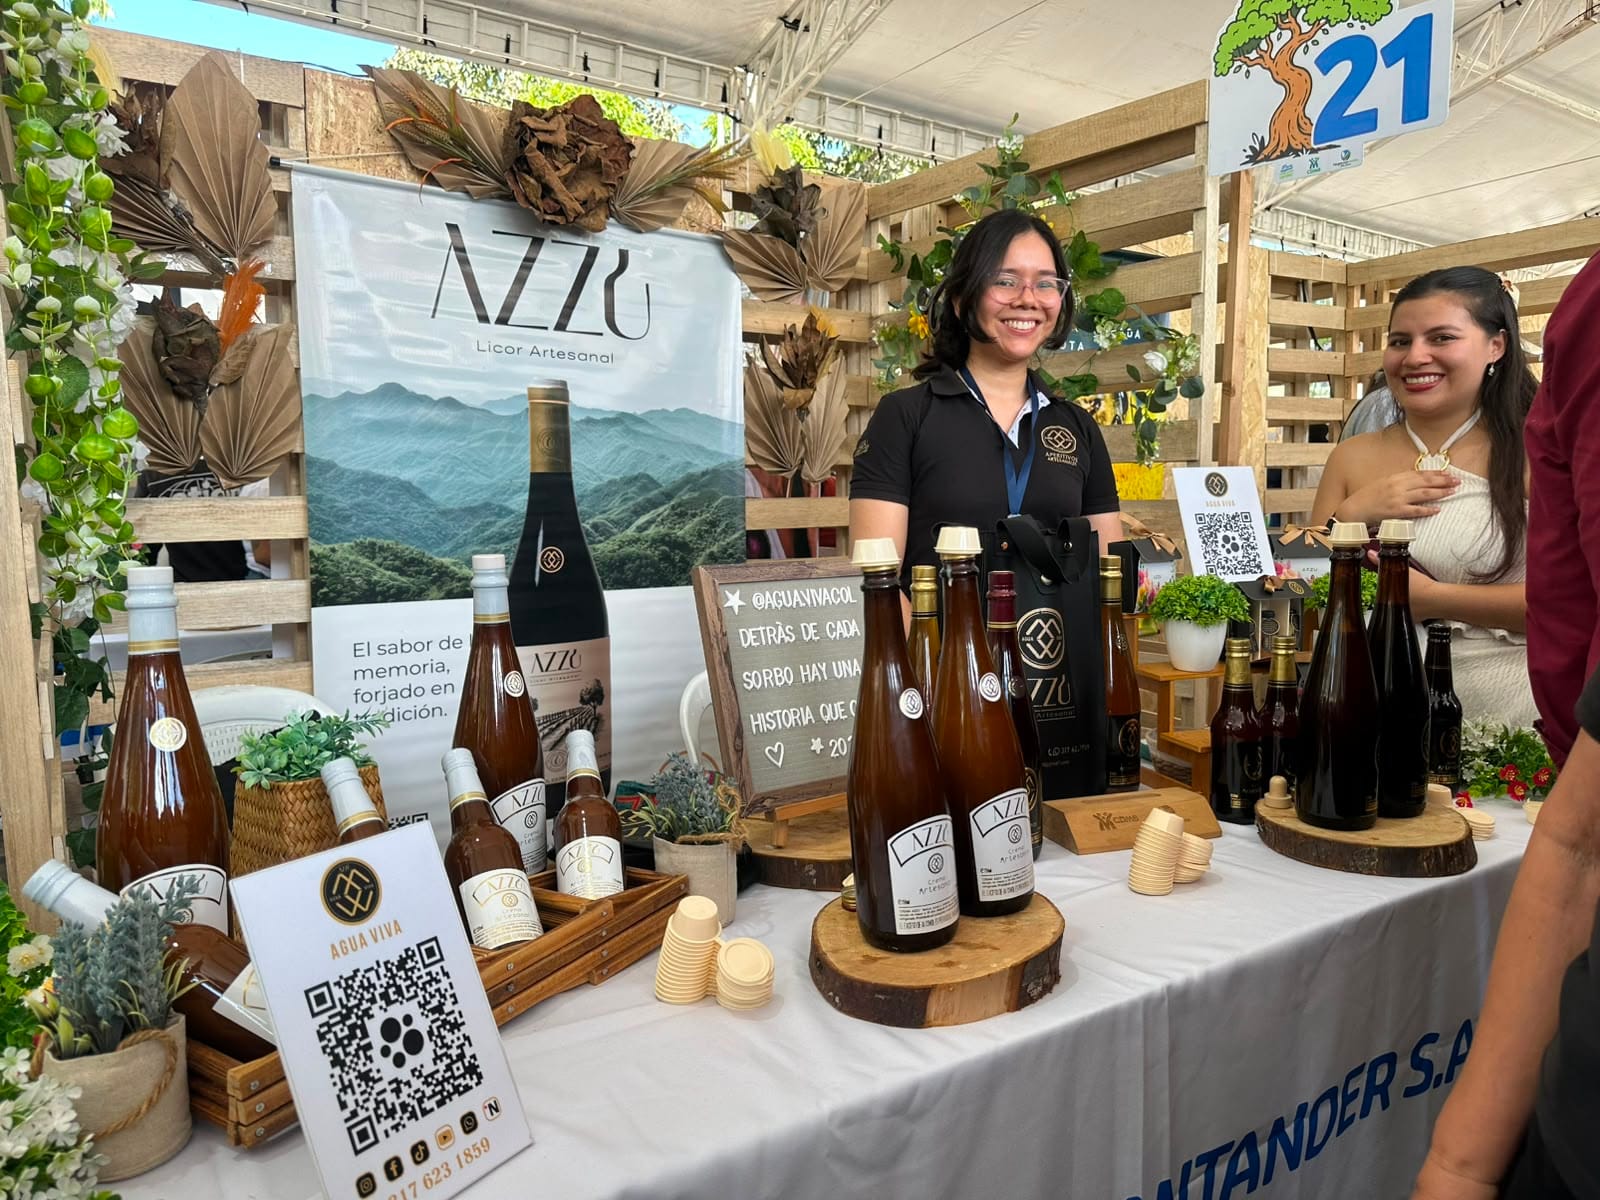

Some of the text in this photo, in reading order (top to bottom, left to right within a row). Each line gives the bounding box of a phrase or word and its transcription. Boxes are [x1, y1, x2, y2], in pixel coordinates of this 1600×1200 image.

[1313, 13, 1433, 145] 21
[431, 222, 650, 340] AZZU
[476, 340, 614, 364] Licor Artesanal
[800, 623, 820, 641] DE
[826, 619, 861, 640] CADA
[353, 641, 371, 658] El
[377, 639, 433, 655] sabor
[439, 635, 463, 650] de
[354, 659, 450, 680] memoria,
[531, 649, 582, 674] AZZU
[742, 658, 862, 690] SORBO HAY UNA
[353, 682, 455, 705] forjado en
[1027, 674, 1071, 706] ZZU
[354, 704, 447, 722] tdición.
[750, 705, 815, 735] HISTORIA
[820, 701, 848, 724] QUE
[829, 735, 852, 757] 20
[330, 920, 402, 960] AGUA VIVA
[1125, 1051, 1397, 1200] NTANDER
[423, 1162, 453, 1190] 623
[455, 1137, 491, 1169] 1859
